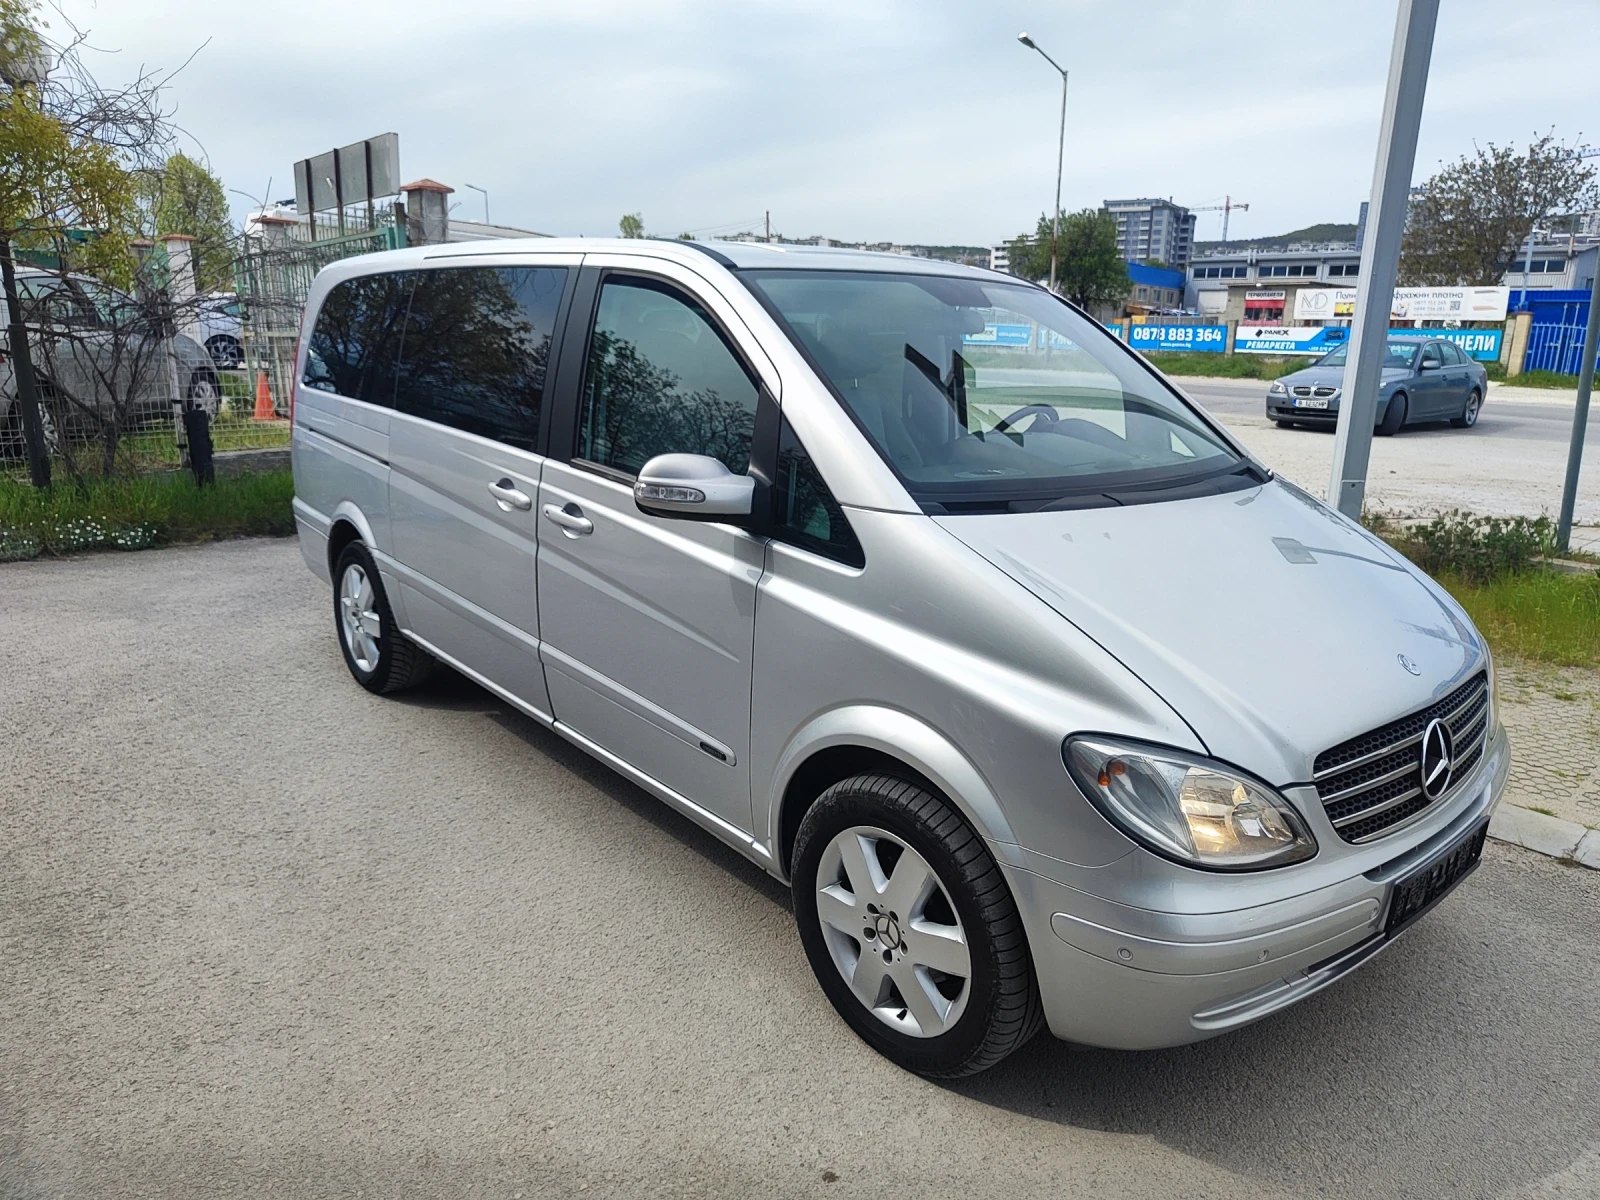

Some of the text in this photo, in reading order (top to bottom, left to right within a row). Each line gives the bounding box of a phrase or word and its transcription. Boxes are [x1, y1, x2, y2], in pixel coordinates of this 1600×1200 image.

[1393, 289, 1429, 301] фражни
[1431, 291, 1464, 299] платна
[1133, 327, 1166, 341] 0878
[1168, 327, 1194, 341] 883
[1195, 328, 1222, 342] 364
[1246, 341, 1296, 350] РЕМАРКЕТА
